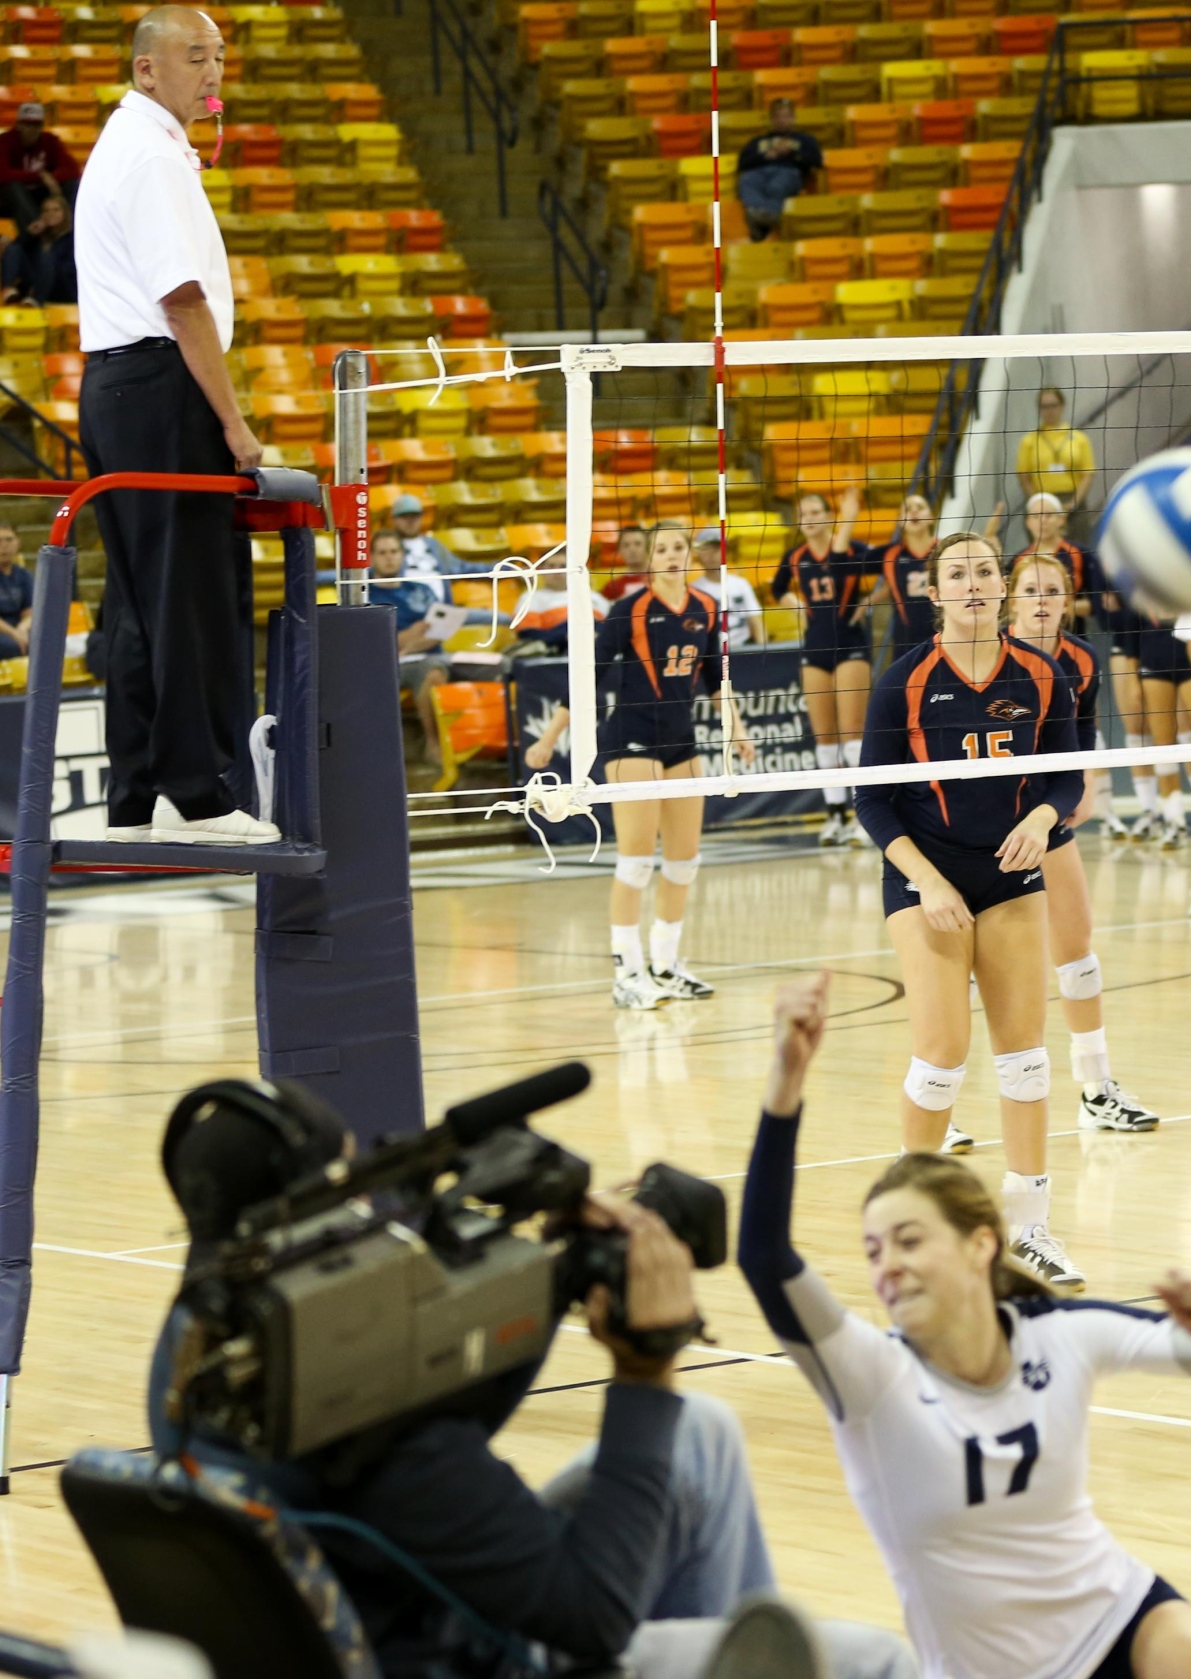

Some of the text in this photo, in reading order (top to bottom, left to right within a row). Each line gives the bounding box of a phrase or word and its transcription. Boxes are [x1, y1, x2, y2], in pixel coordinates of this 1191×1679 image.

[356, 507, 367, 561] senoh
[809, 576, 836, 601] 13
[663, 644, 699, 677] 12
[961, 730, 1013, 760] 15
[964, 1422, 1040, 1508] 17
